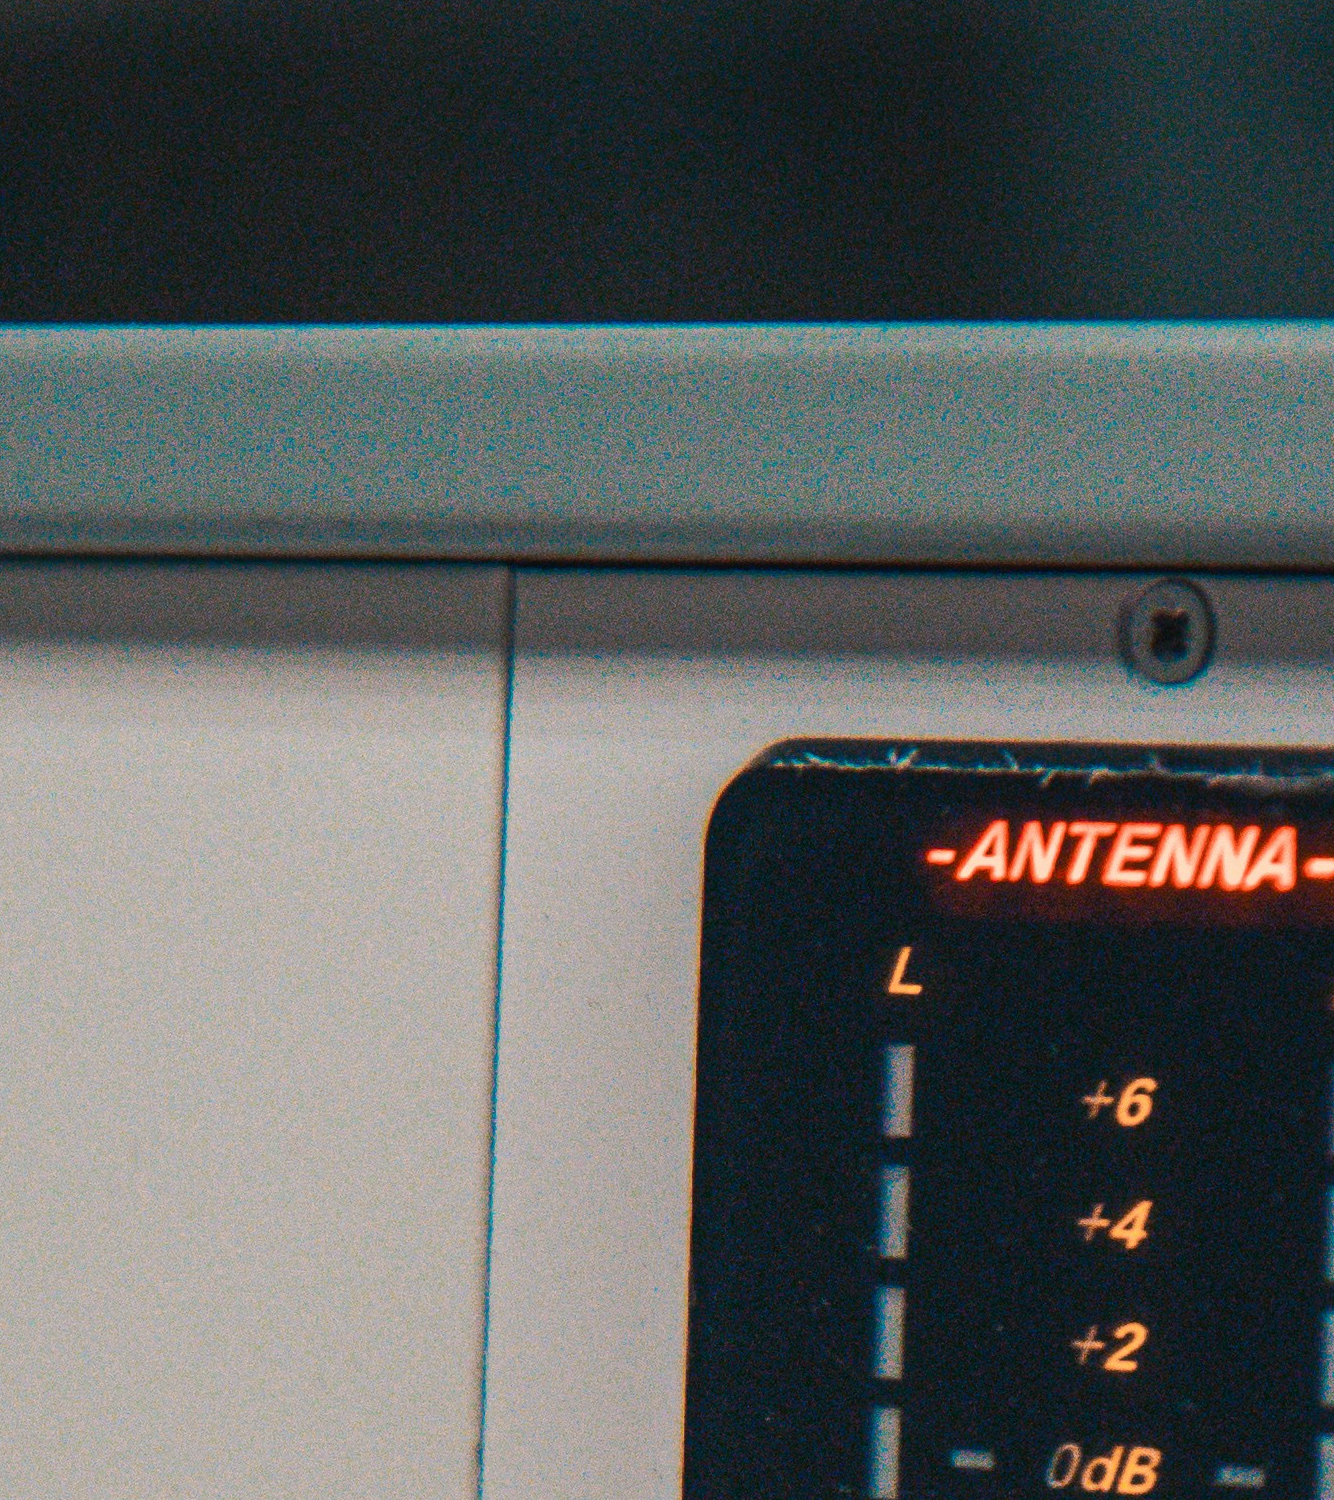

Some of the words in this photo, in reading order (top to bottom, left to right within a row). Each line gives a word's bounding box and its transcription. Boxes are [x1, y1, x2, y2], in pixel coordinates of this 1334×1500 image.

[886, 946, 924, 997] L
[1080, 1076, 1159, 1129] +6
[1076, 1198, 1154, 1252] +4
[1071, 1320, 1150, 1375] +2
[1045, 1442, 1163, 1498] 0dB
